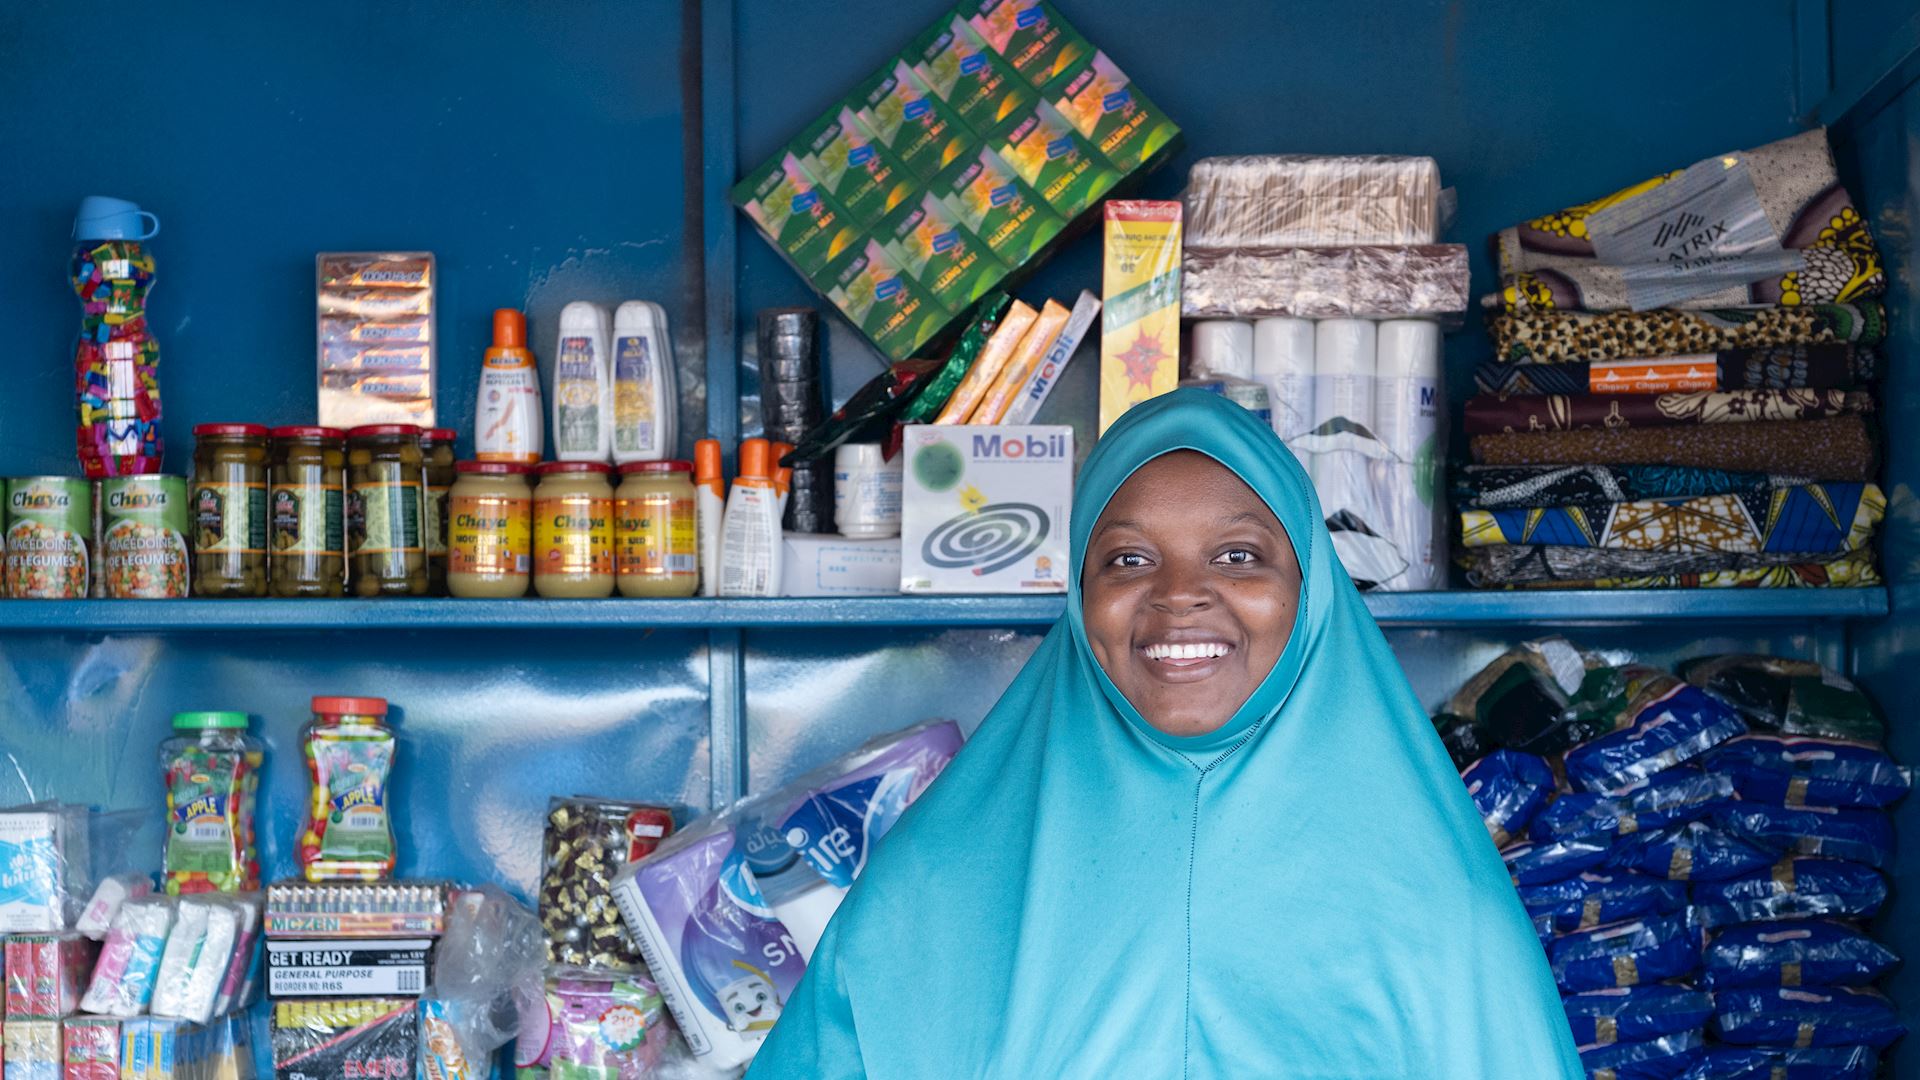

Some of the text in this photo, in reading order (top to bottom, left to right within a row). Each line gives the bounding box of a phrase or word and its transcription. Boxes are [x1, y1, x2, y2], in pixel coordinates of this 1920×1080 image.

[1101, 110, 1149, 153] KILLING MAT
[988, 205, 1036, 248] KILLING MAT
[1657, 220, 1728, 262] ATRIX
[1030, 335, 1074, 400] Mobil
[972, 434, 1065, 458] Mobil
[12, 491, 69, 509] Chaya
[110, 491, 166, 509] Chaya
[457, 514, 507, 530] Chaya
[554, 514, 605, 531] Chaya
[187, 796, 217, 819] APPLE
[342, 787, 376, 810] APPLE
[269, 950, 352, 966] GET READY
[274, 969, 373, 980] GENERAL PURPOSE
[274, 982, 308, 992] REORDER
[322, 981, 343, 991] R6S
